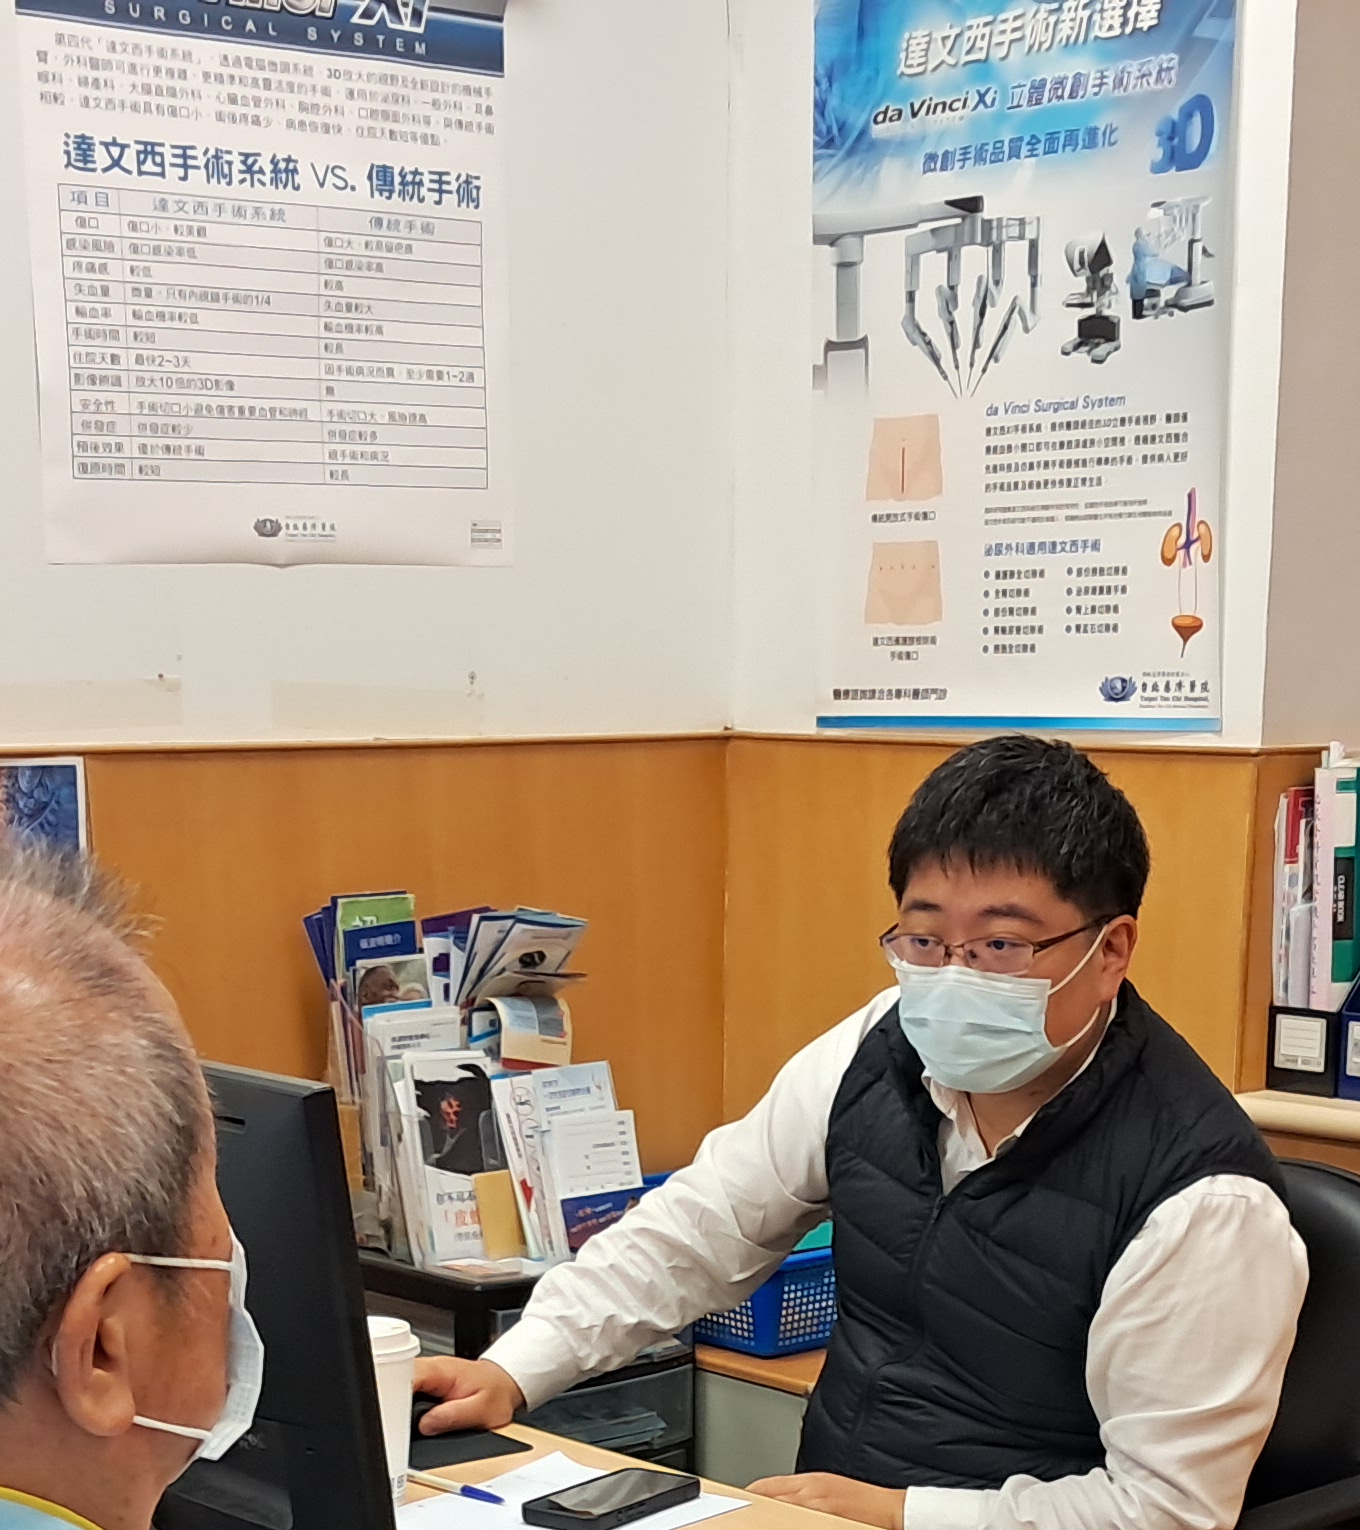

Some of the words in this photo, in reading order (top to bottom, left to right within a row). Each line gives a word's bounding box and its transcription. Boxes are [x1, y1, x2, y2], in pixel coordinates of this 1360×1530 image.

[104, 0, 277, 36] SURGICAL
[307, 26, 426, 56] SYSTEM
[896, 0, 1162, 76] 達文西手術新選擇
[872, 105, 903, 125] da
[909, 91, 970, 120] Vinci
[970, 86, 998, 112] Xi
[921, 123, 1119, 176] 微創手術品質全面再進化
[1150, 93, 1215, 175] 3D
[63, 132, 300, 191] 達文西手術系統
[311, 162, 356, 192] VS.
[367, 162, 481, 210] 傳統手術
[152, 197, 287, 223] 達文西手術系統
[369, 216, 435, 236] 傳統手術
